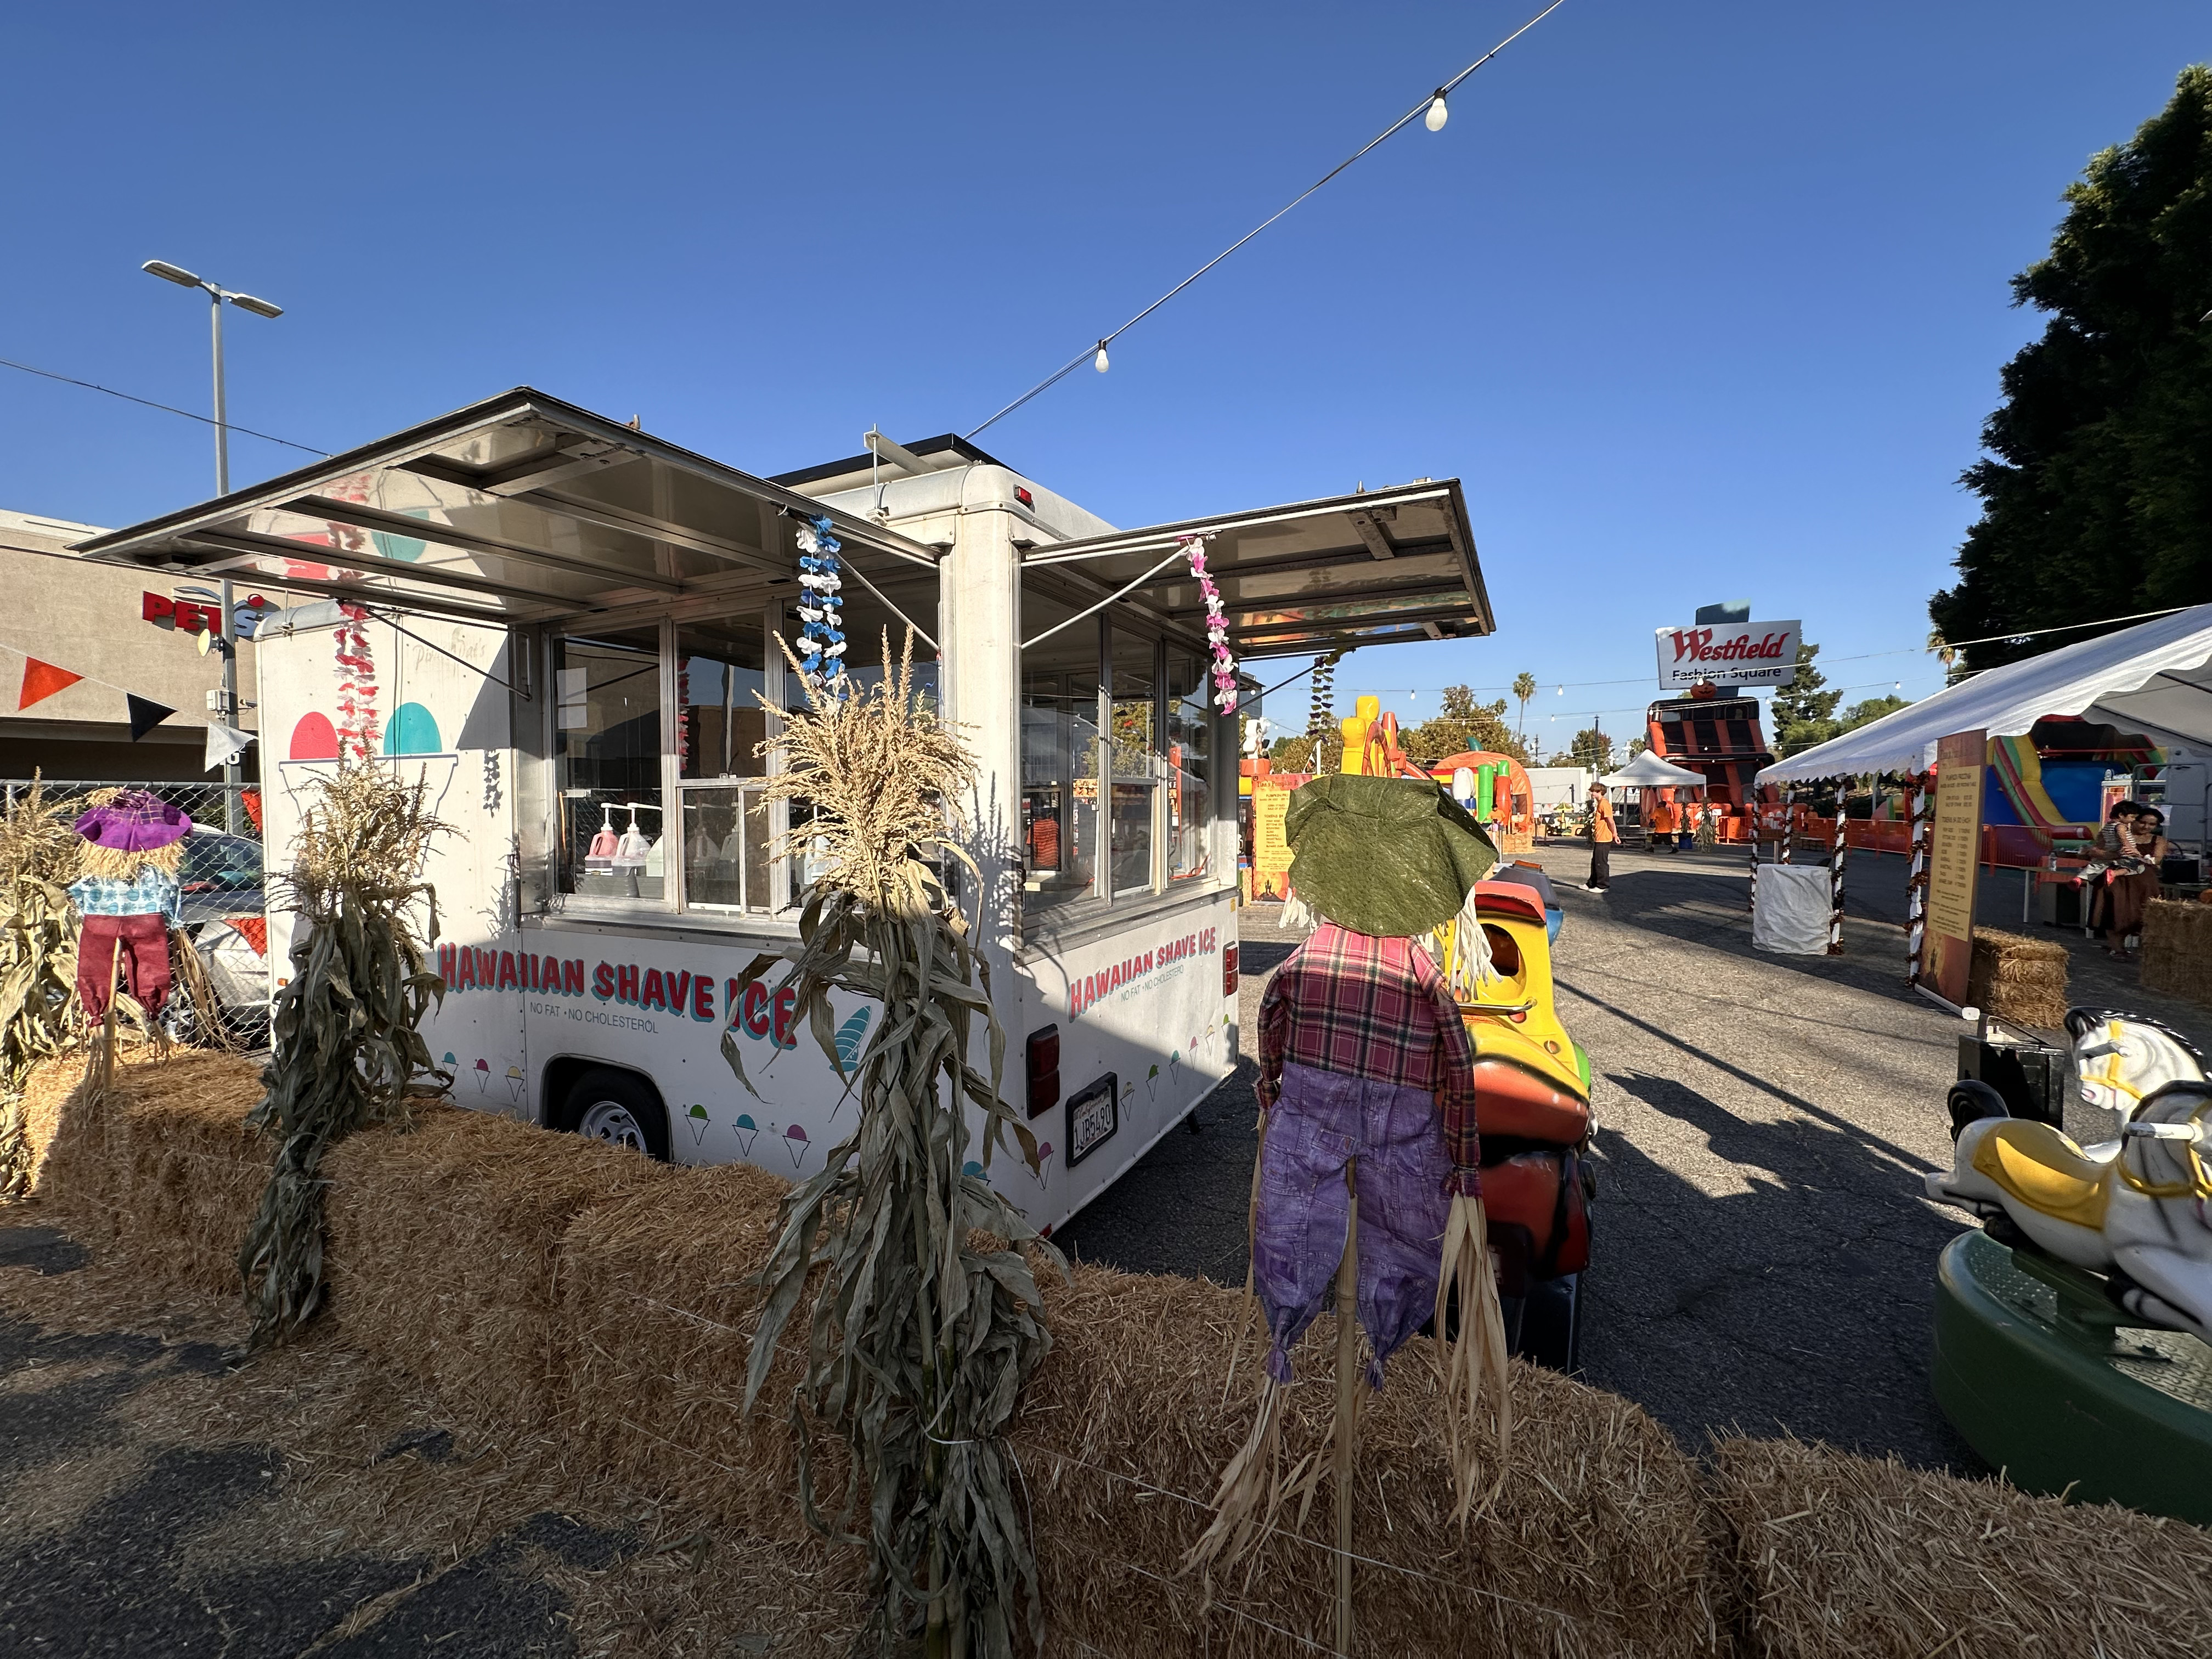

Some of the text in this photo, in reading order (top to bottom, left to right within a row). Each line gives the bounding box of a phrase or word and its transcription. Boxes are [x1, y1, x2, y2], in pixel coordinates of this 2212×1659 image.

[143, 590, 273, 637] PETS
[1669, 628, 1790, 663] Westfield
[1672, 667, 1781, 681] Fashion Square
[1068, 927, 1216, 1023] HAWAIIAN SHAVE ICE
[1121, 990, 1130, 1002] NO
[1131, 984, 1141, 997] FAT
[1144, 979, 1153, 991] NO
[437, 942, 798, 1050] HAWAIIAN SHAVE ICE
[530, 1002, 658, 1034] NO FAT NO CHOLESTEROL
[1077, 1093, 1105, 1119] California
[1074, 1103, 1111, 1150] 1JB5490
